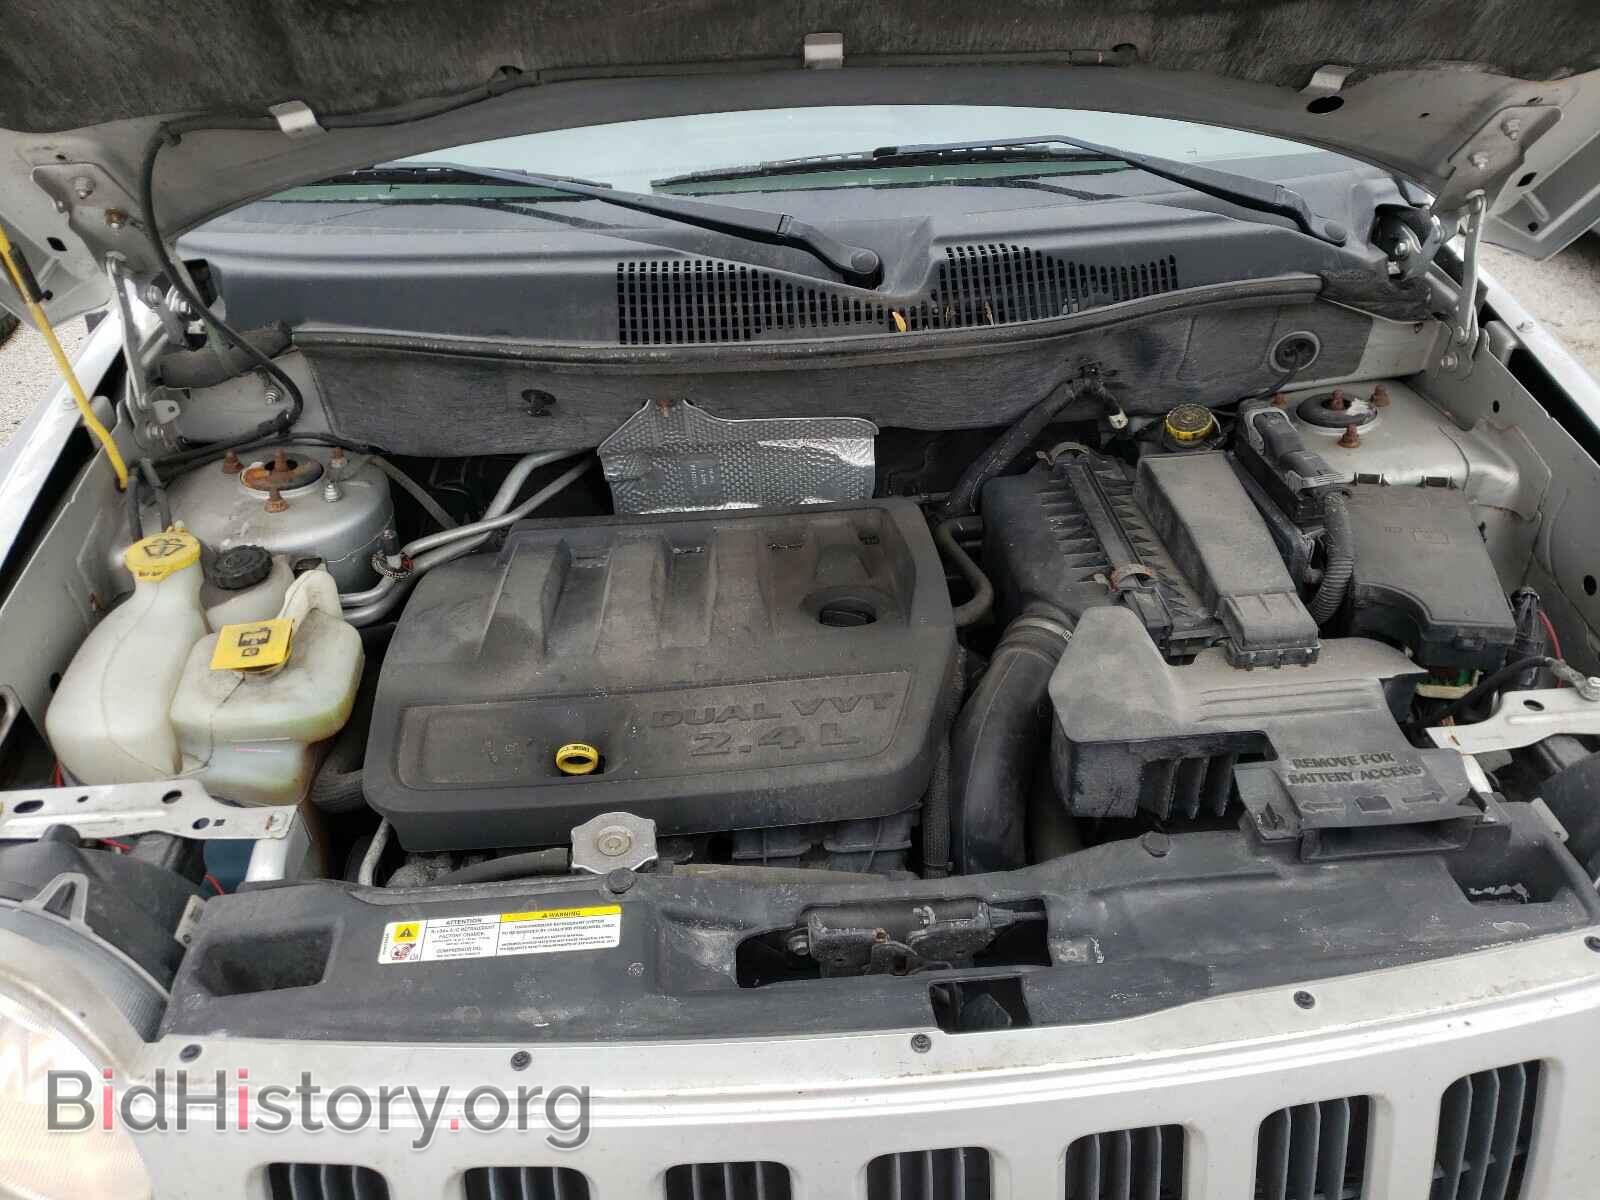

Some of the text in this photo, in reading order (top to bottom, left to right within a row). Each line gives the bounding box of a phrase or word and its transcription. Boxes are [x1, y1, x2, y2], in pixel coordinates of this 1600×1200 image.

[652, 692, 896, 728] DUAL VVT
[688, 722, 862, 757] 2.4L
[1292, 752, 1396, 769] REMOVE FOR
[1287, 766, 1422, 785] BATTERY ACCESS
[445, 918, 482, 926] ATTENTION
[549, 910, 581, 919] WARNING
